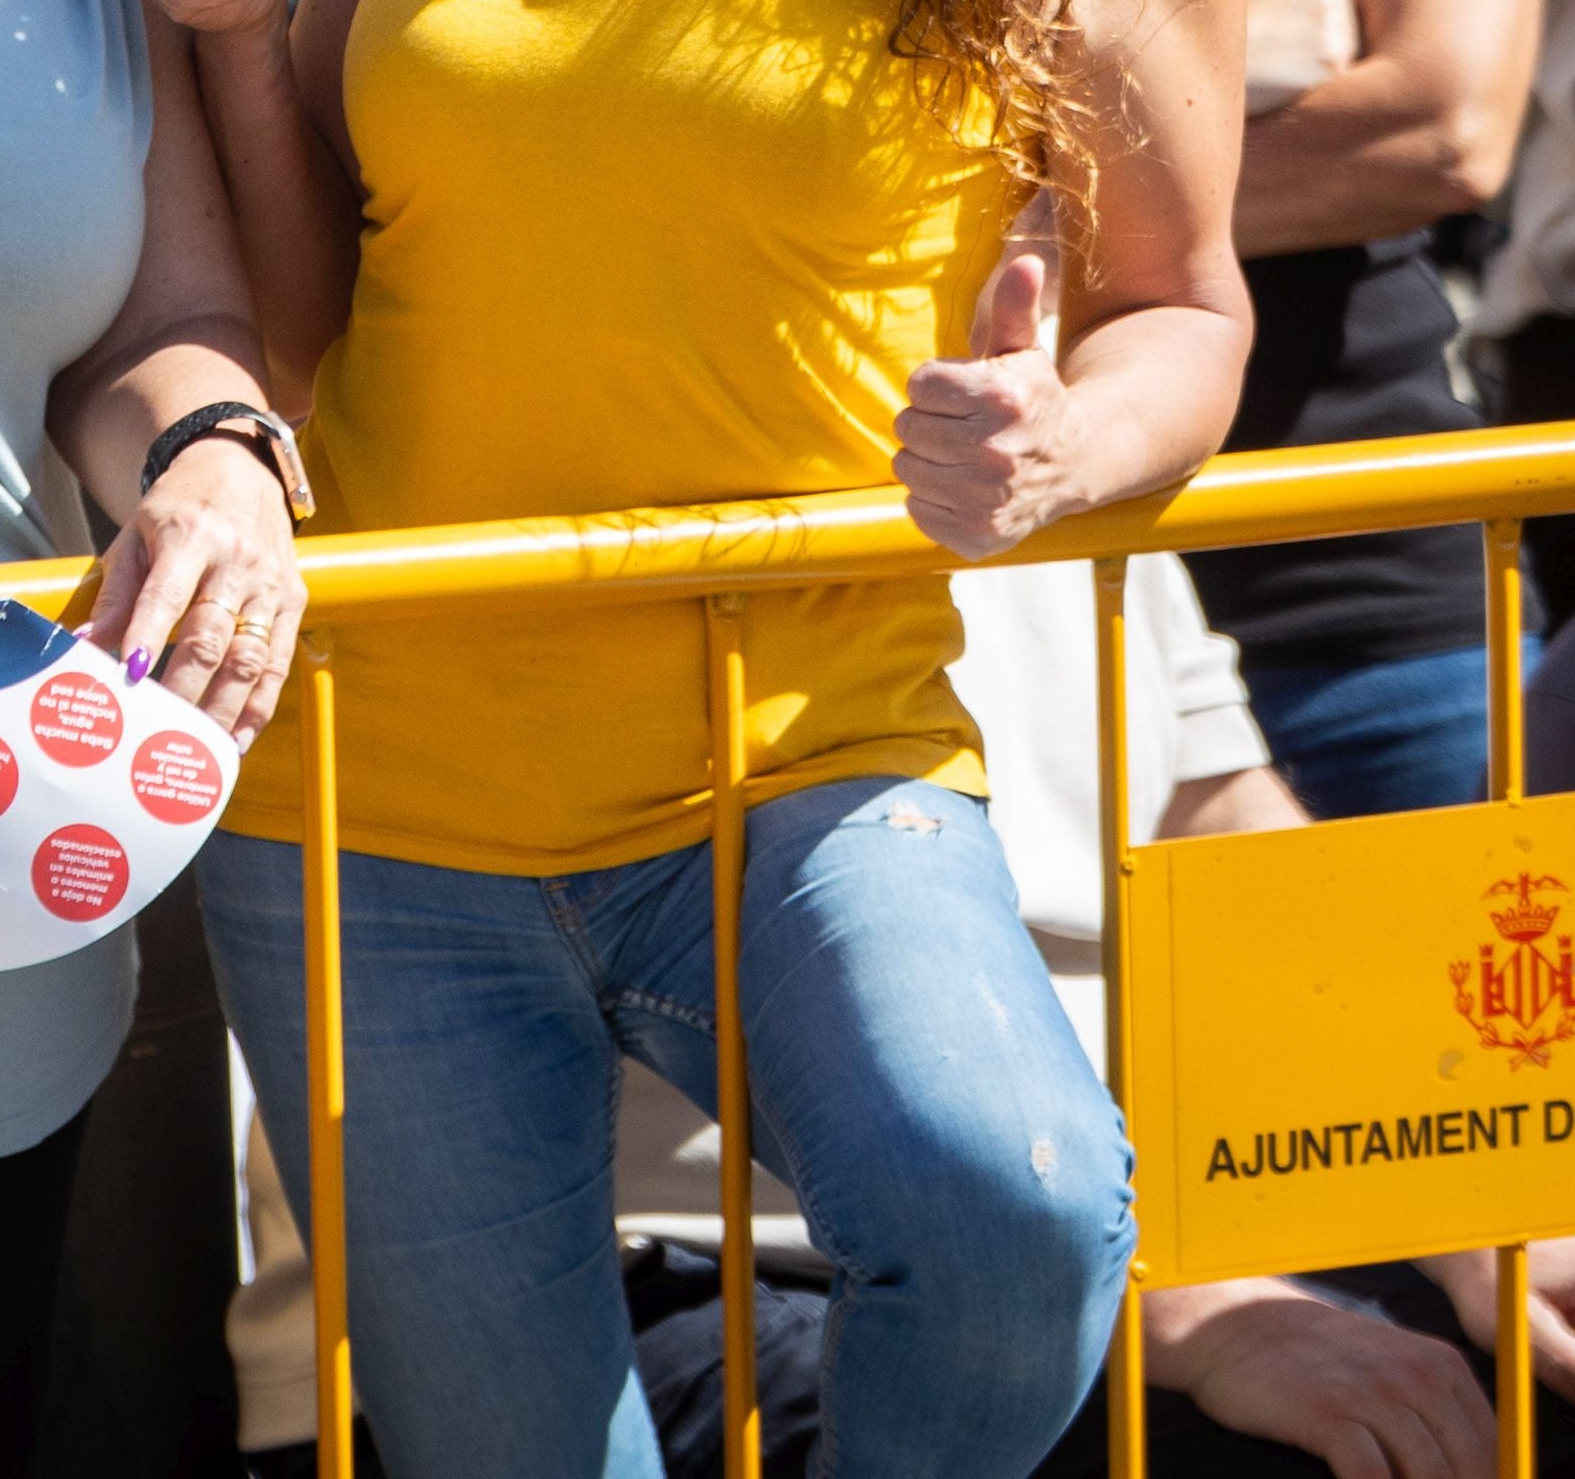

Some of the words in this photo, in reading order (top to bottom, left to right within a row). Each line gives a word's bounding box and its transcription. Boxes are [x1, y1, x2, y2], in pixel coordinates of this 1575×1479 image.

[39, 696, 57, 708] no
[58, 700, 70, 712] si
[71, 702, 117, 723] incluso
[32, 724, 79, 741] mucha
[80, 733, 114, 750] Beba
[51, 839, 122, 858] estacionados
[50, 876, 59, 884] o
[60, 878, 108, 893] menores
[86, 894, 103, 906] No
[1205, 1104, 1530, 1183] AJUNTAMENT
